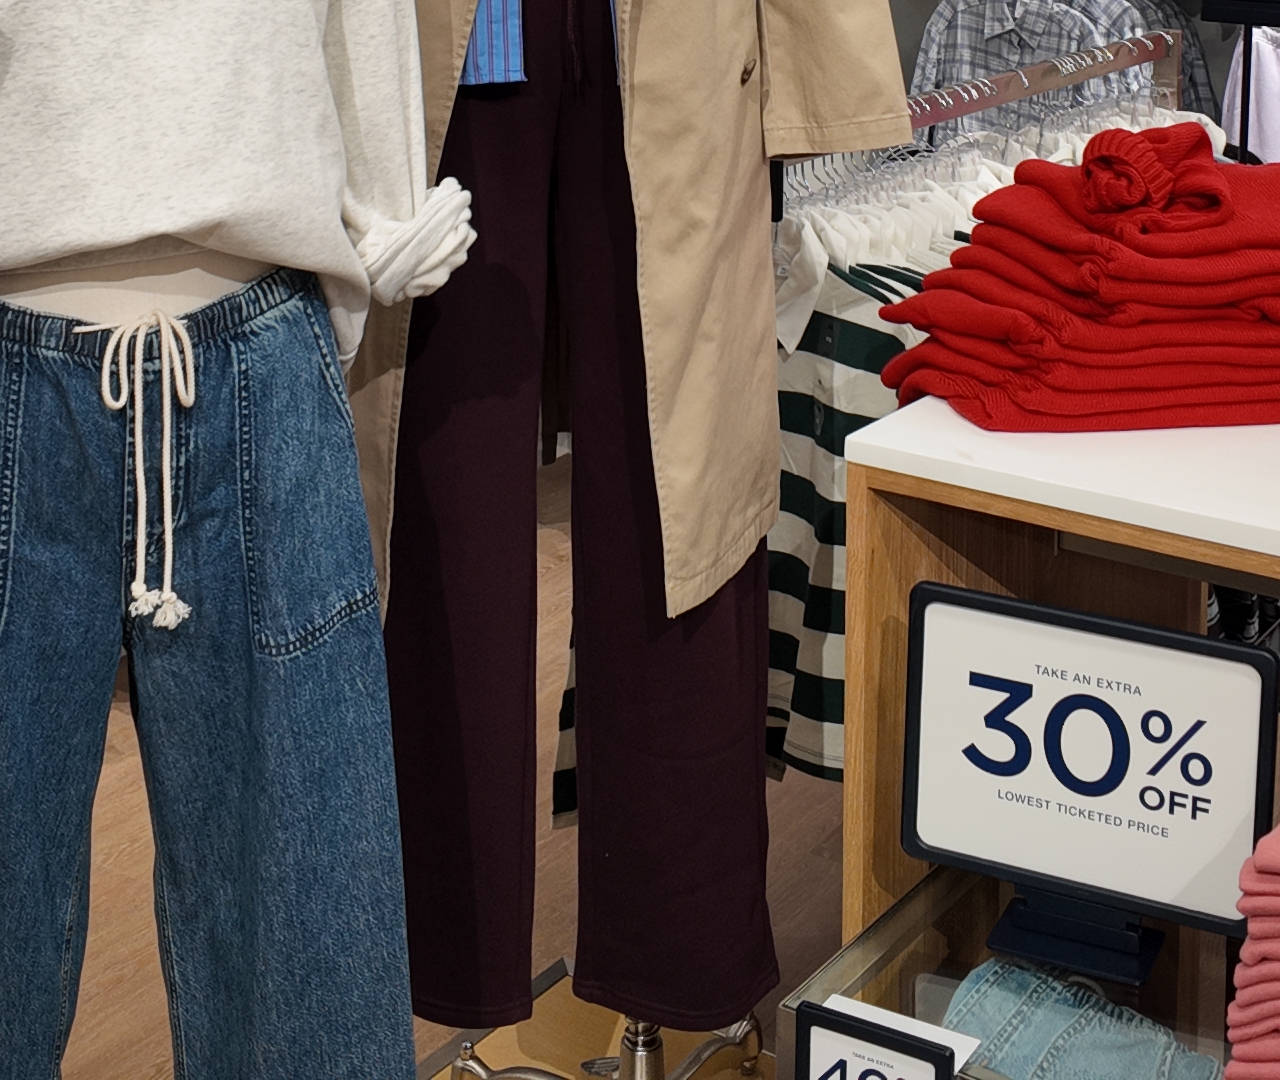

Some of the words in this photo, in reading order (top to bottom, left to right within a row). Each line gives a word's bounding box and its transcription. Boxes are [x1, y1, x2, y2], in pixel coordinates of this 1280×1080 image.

[1034, 663, 1069, 681] TAKE
[1072, 673, 1091, 686] AN
[1096, 678, 1142, 697] EXTRA
[961, 670, 1213, 798] 30%
[1139, 785, 1212, 820] OFF
[997, 788, 1052, 810] LOWEST
[1055, 802, 1123, 827] TICKETED
[1127, 819, 1170, 838] PRICE
